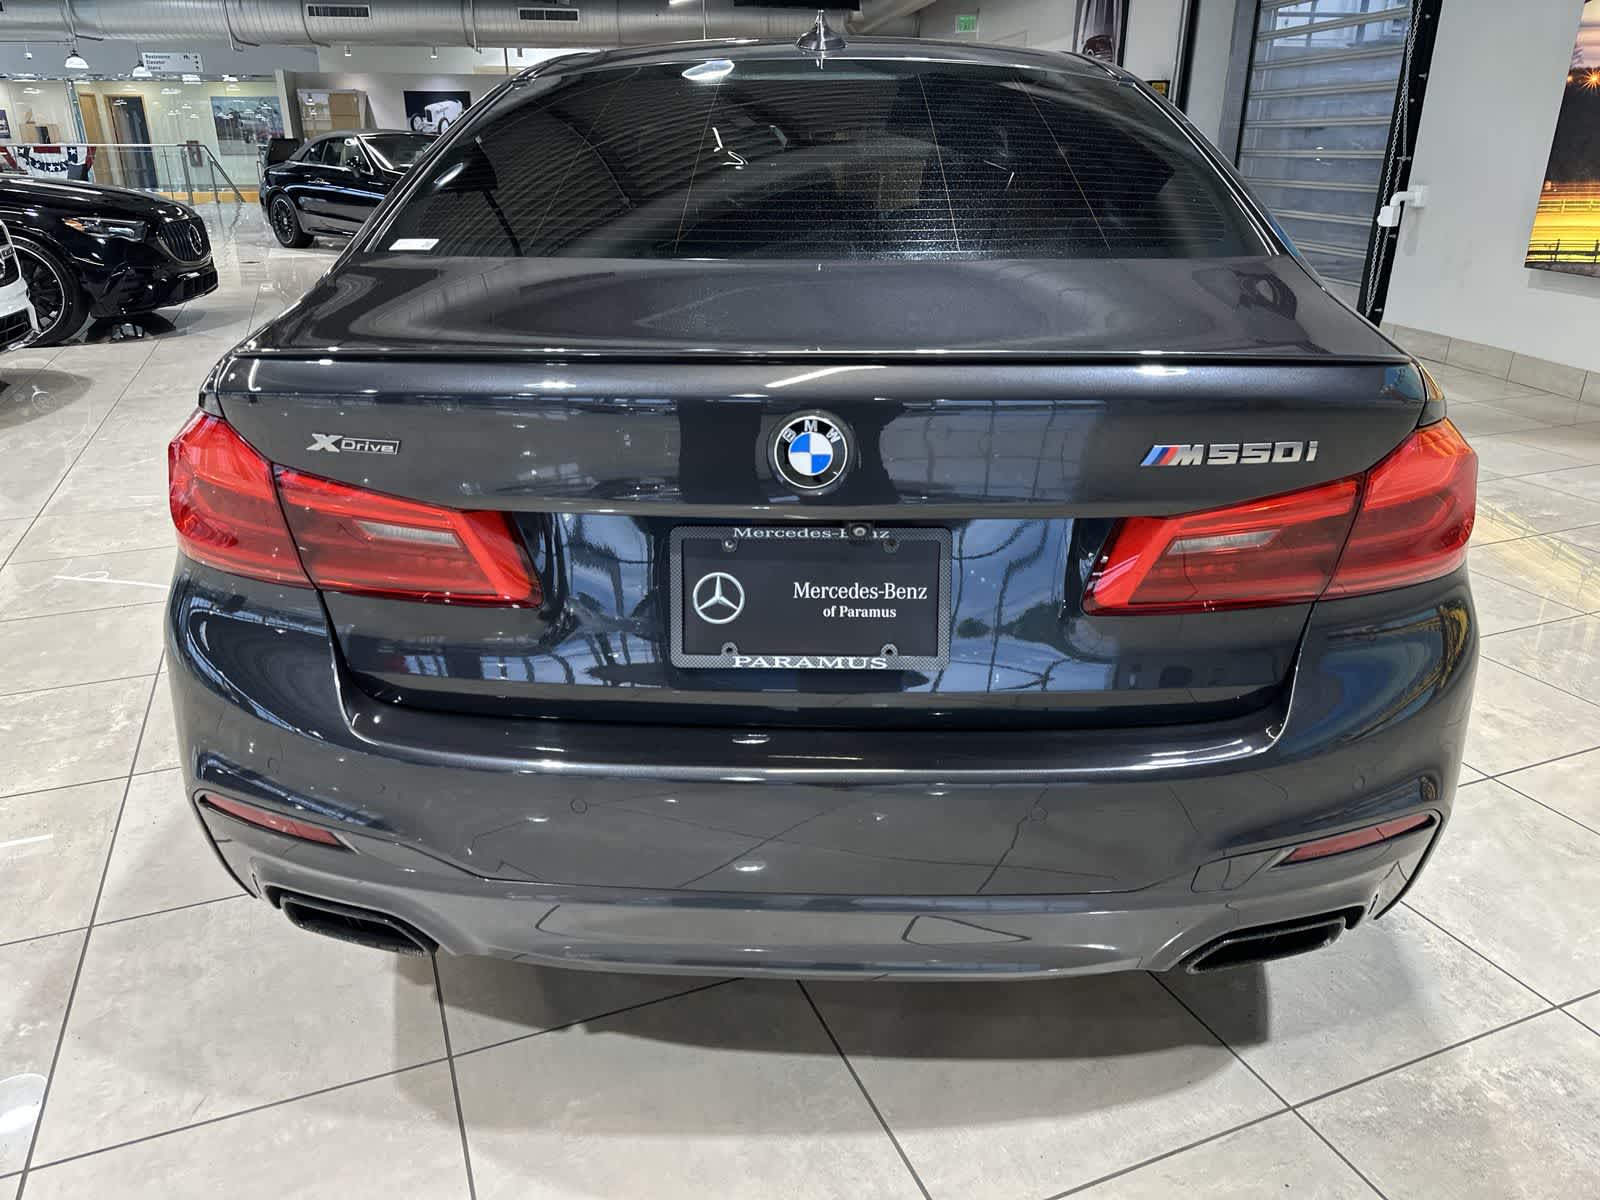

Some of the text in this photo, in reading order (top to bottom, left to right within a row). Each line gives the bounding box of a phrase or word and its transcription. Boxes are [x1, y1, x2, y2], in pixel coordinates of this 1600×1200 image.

[782, 419, 841, 443] BMW
[1166, 440, 1319, 466] M550i
[793, 581, 928, 600] Mercedes-Benz
[822, 605, 897, 618] of Paramus
[732, 655, 888, 670] PARAMUS
